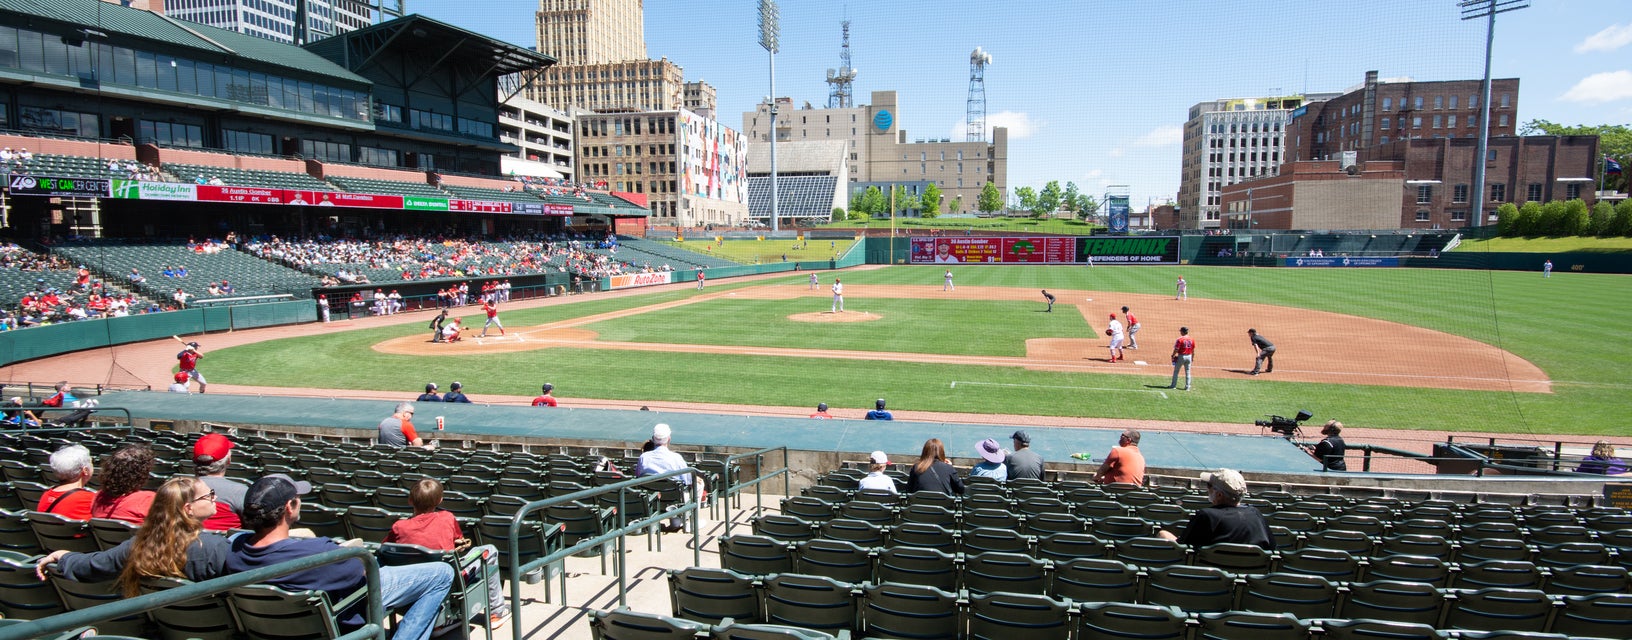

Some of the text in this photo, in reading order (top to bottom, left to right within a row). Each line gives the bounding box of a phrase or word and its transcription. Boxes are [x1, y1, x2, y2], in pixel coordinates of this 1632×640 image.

[142, 183, 191, 193] Holiday Inn
[1083, 238, 1171, 255] TERMINIX
[634, 273, 665, 285] AutoZone
